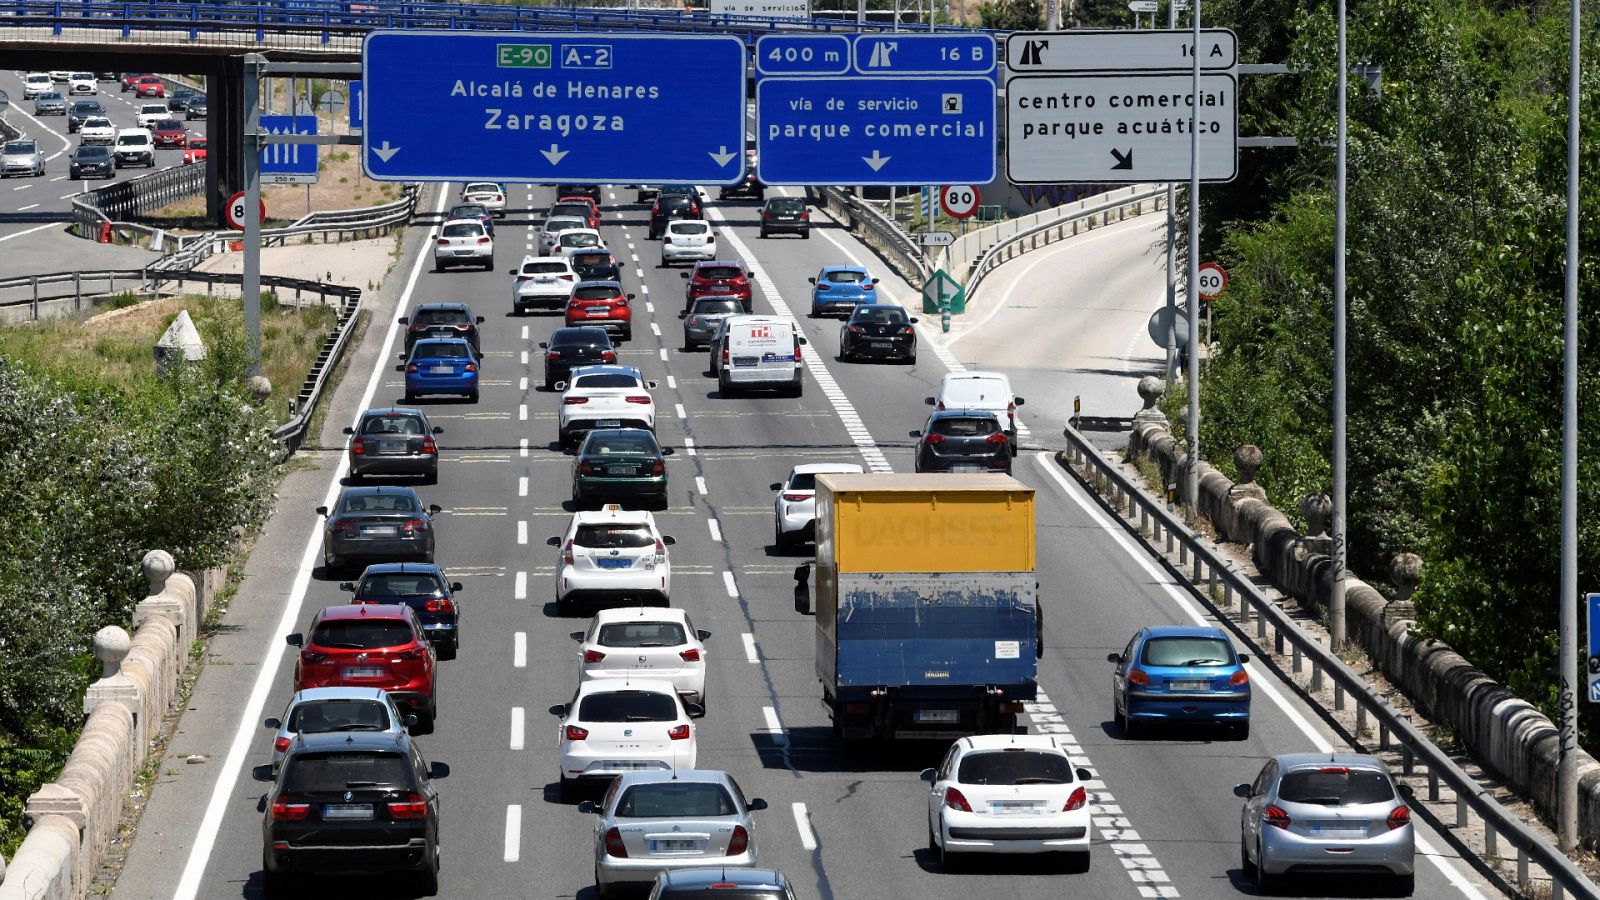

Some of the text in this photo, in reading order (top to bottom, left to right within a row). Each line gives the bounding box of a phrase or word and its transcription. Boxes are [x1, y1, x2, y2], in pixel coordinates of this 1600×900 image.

[500, 47, 609, 66] E-90 A-2
[768, 47, 840, 62] 400 m
[940, 46, 984, 61] 16 B
[1209, 43, 1223, 57] A
[450, 79, 660, 99] Alcalá de Henares
[789, 96, 919, 111] vía de servicio
[1018, 90, 1225, 109] centro comercial
[484, 108, 625, 138] Zaragoza
[769, 120, 984, 141] parque comercial
[1023, 118, 1220, 140] parque acuático
[949, 192, 972, 204] 80
[1199, 275, 1220, 287] 60
